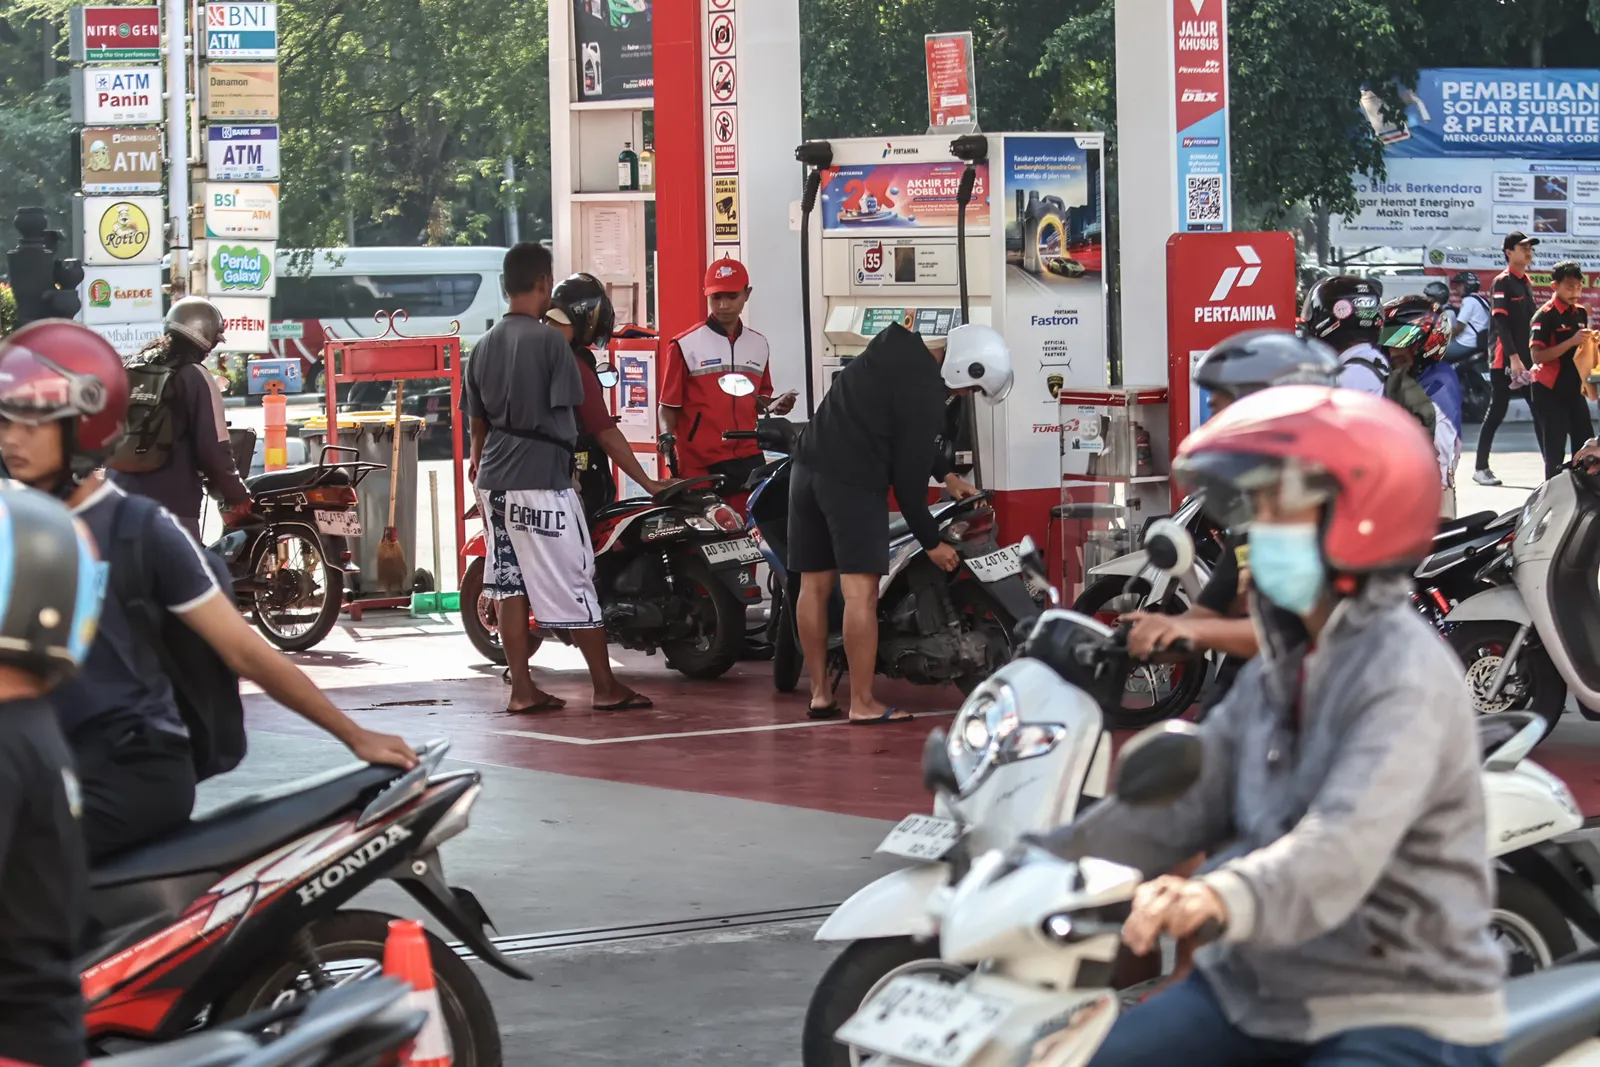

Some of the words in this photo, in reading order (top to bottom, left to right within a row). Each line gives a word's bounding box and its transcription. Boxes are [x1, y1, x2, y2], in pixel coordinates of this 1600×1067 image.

[229, 7, 266, 26] BNI
[87, 24, 158, 38] NITROGEN
[1178, 21, 1218, 37] JALUR
[210, 34, 240, 48] ATM
[1179, 38, 1219, 50] KHUSUS
[112, 74, 149, 90] ATM
[210, 77, 248, 86] Danamon
[1181, 92, 1218, 102] DEX
[1442, 82, 1600, 100] PEMBELIAN
[98, 92, 148, 108] Panin
[1443, 101, 1512, 114] SOLAR
[1518, 102, 1599, 115] SUBSIDI
[1442, 116, 1463, 132] &
[1466, 116, 1599, 133] PERTALITE
[1443, 134, 1543, 142] MENGGUNAKAN
[1546, 135, 1564, 143] QR
[1567, 135, 1599, 143] CODE
[114, 152, 157, 172] ATM
[222, 145, 262, 165] ATM
[907, 179, 941, 188] AKHIR
[944, 178, 982, 186] PEN
[1372, 182, 1401, 195] Bijak
[1406, 183, 1482, 194] Berkendara
[941, 187, 984, 195] UNTNG
[214, 194, 236, 206] BSI
[1359, 200, 1377, 209] gar
[1381, 198, 1416, 207] Hemat
[1420, 198, 1474, 209] Energinya
[252, 210, 271, 220] ATM
[1376, 208, 1410, 217] Makin
[1413, 208, 1448, 217] Terasa
[220, 253, 261, 271] Pentol
[864, 254, 881, 268] 135
[224, 269, 261, 285] Galaxy
[114, 288, 152, 299] GARDOE
[1194, 305, 1276, 322] PERTAMINA
[1031, 316, 1078, 326] Fastron
[510, 503, 553, 529] EIGHT
[556, 511, 565, 530] C
[705, 545, 718, 556] AD
[718, 541, 740, 553] 5177
[984, 552, 1009, 567] 4078
[296, 824, 412, 906] HONDA
